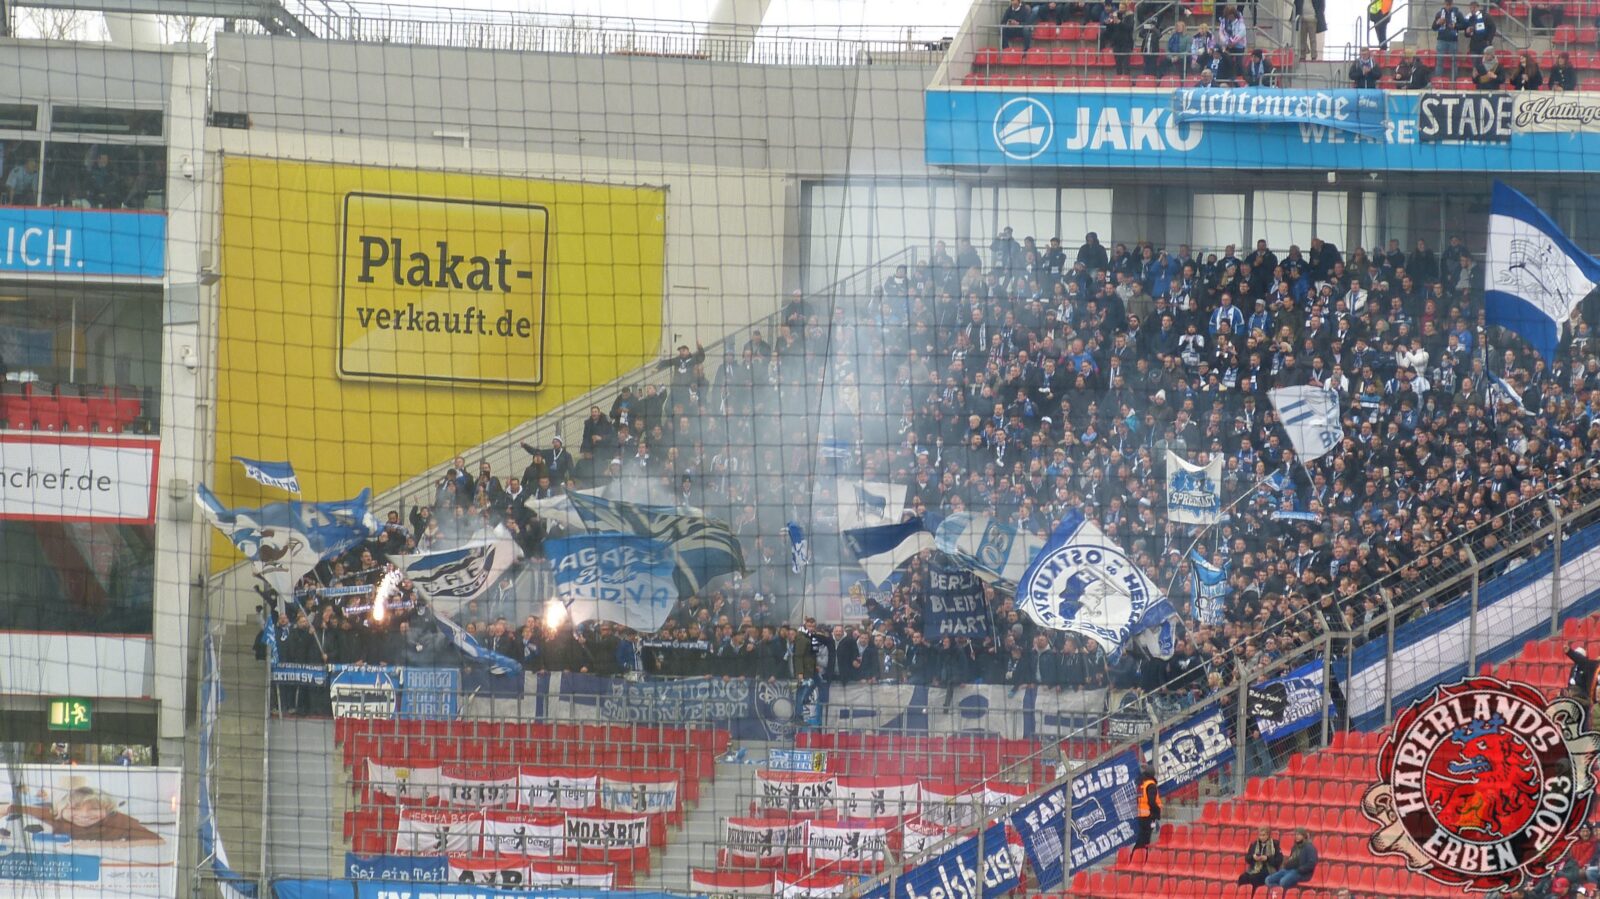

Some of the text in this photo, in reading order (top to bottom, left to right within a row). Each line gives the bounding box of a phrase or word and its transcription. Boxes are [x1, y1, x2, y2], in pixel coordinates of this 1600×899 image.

[1180, 88, 1350, 121] Lichtenrade
[1421, 95, 1512, 137] STADE
[1066, 106, 1204, 151] JAKO
[0, 227, 84, 268] ICH.
[358, 236, 533, 293] Plakat-
[356, 303, 532, 339] verkauft.de
[940, 615, 988, 634] HART
[603, 698, 749, 722] STADIONVERBOT
[1025, 789, 1067, 833] FAN
[1071, 763, 1130, 800] CLUB
[408, 812, 475, 825] HERTHA BSC
